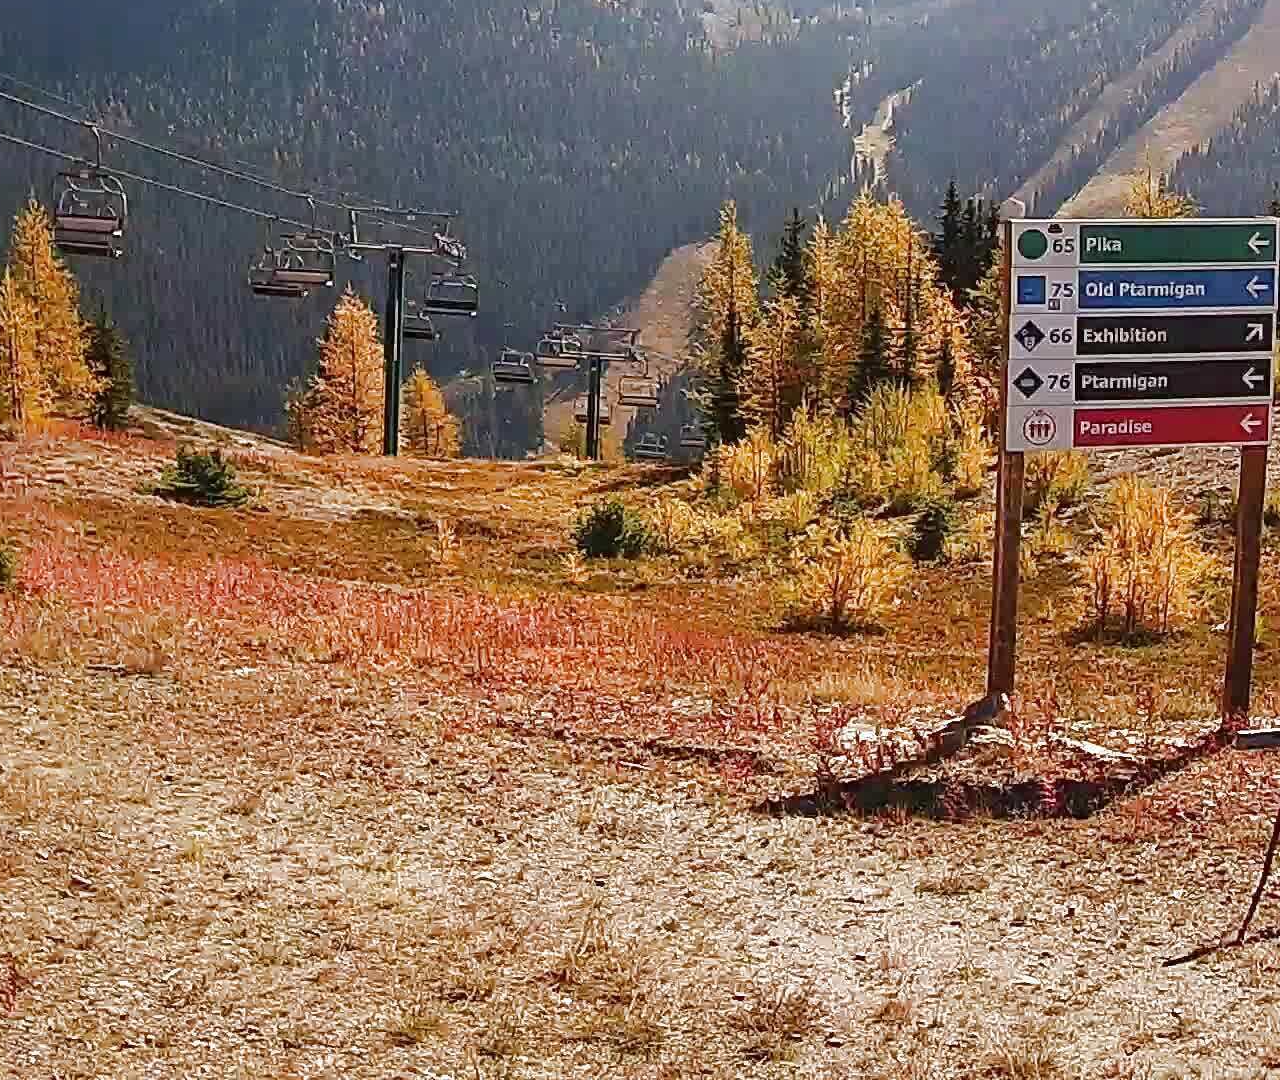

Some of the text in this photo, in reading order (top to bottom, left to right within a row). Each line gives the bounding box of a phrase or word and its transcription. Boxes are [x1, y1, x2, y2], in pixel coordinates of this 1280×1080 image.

[1052, 237, 1122, 253] 65 Pika
[1051, 281, 1205, 298] 75 Old Ptarmigan
[1049, 327, 1168, 344] 66 Exhibition
[1047, 374, 1168, 390] 76 Ptarmigan
[1080, 419, 1153, 435] Paradise
